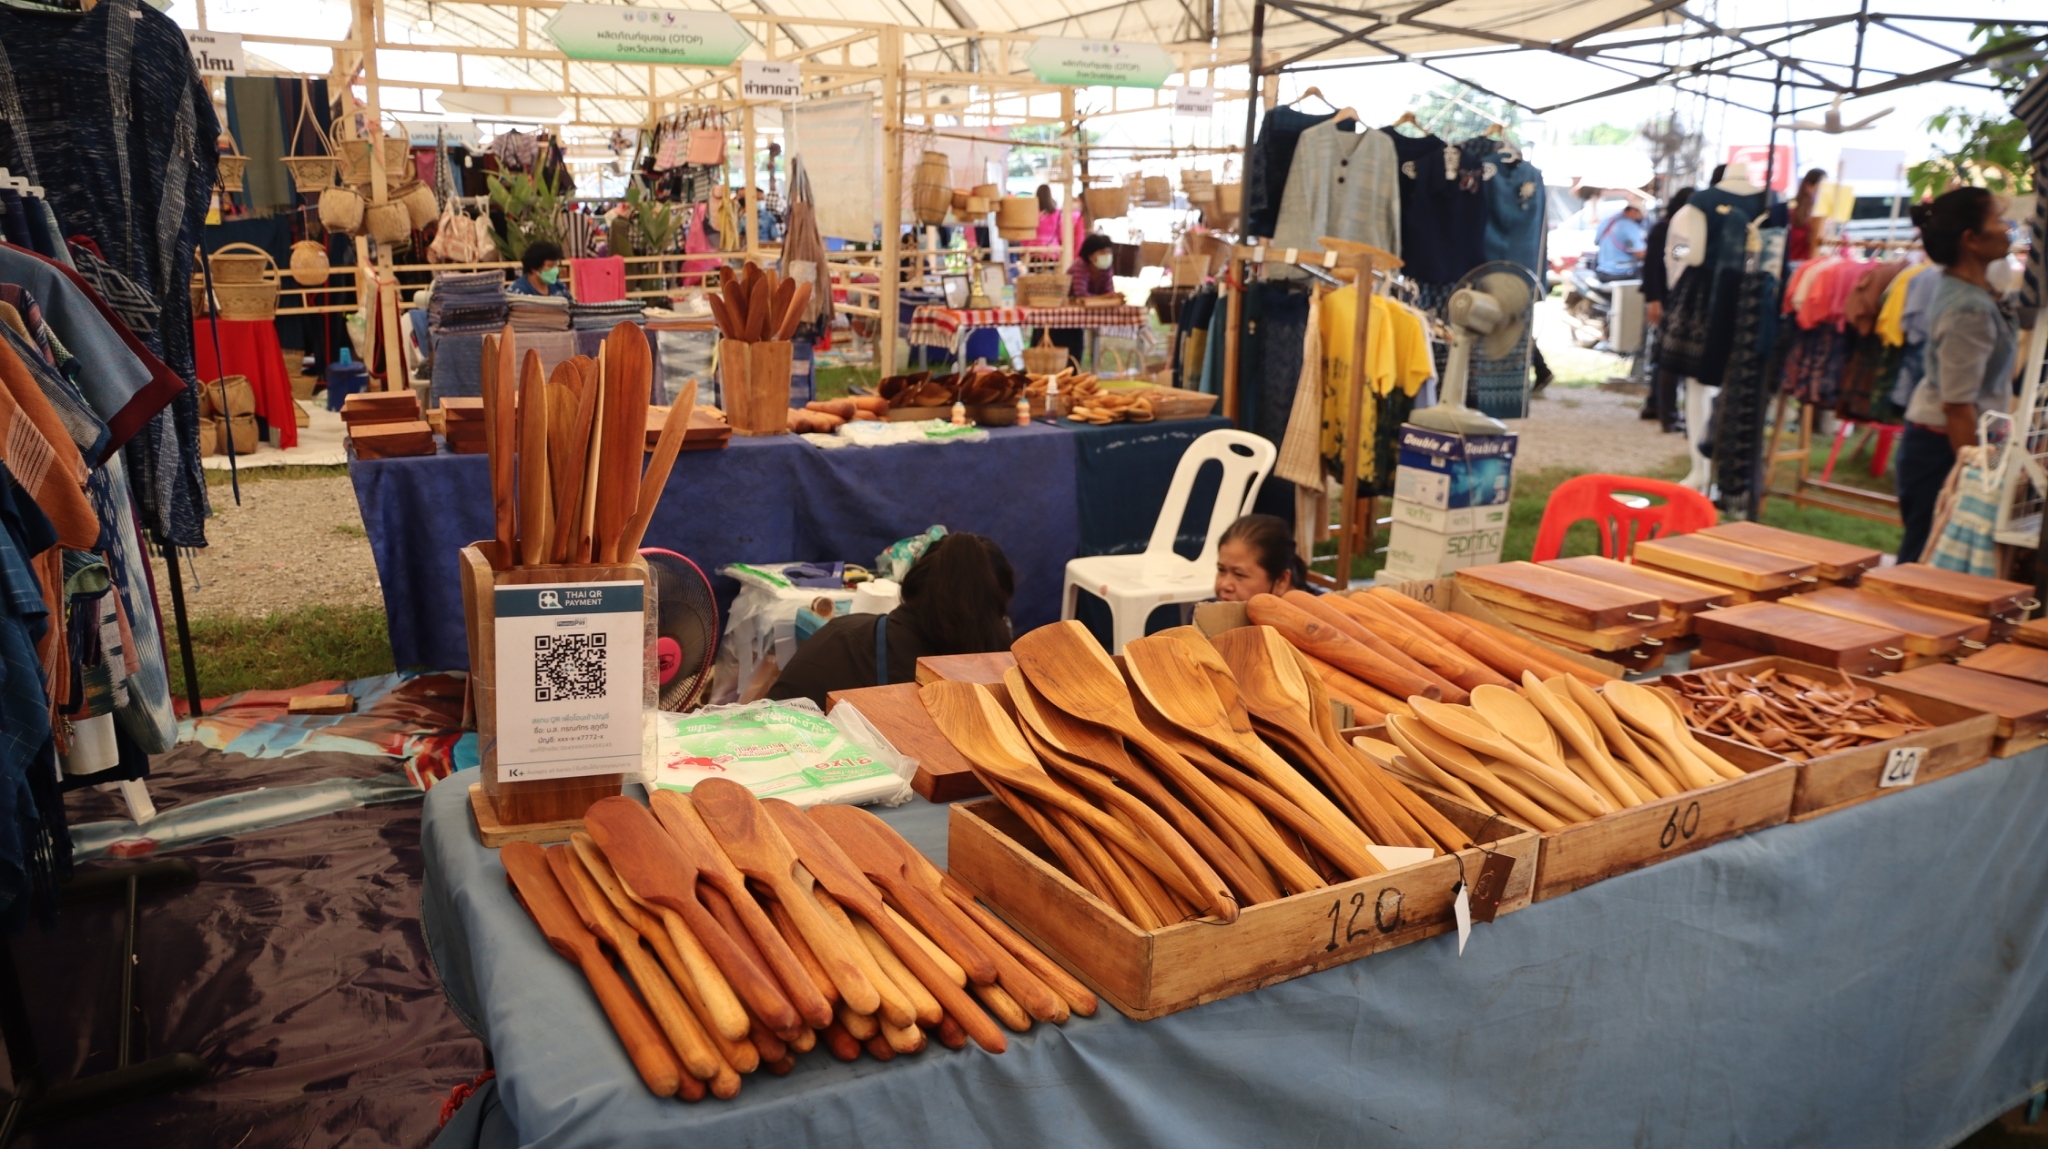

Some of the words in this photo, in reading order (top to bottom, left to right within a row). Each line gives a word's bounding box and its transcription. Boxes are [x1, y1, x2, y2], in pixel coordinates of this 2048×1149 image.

[669, 34, 703, 46] (OTOP)
[1403, 433, 1440, 451] Double
[1440, 442, 1451, 453] A
[1447, 529, 1500, 556] spring
[565, 591, 587, 599] THAI
[589, 590, 603, 598] QR
[565, 598, 602, 607] PAYMENT
[551, 716, 561, 724] QR
[1888, 750, 1915, 780] 20
[509, 768, 525, 777] K+
[1660, 801, 1700, 849] 60
